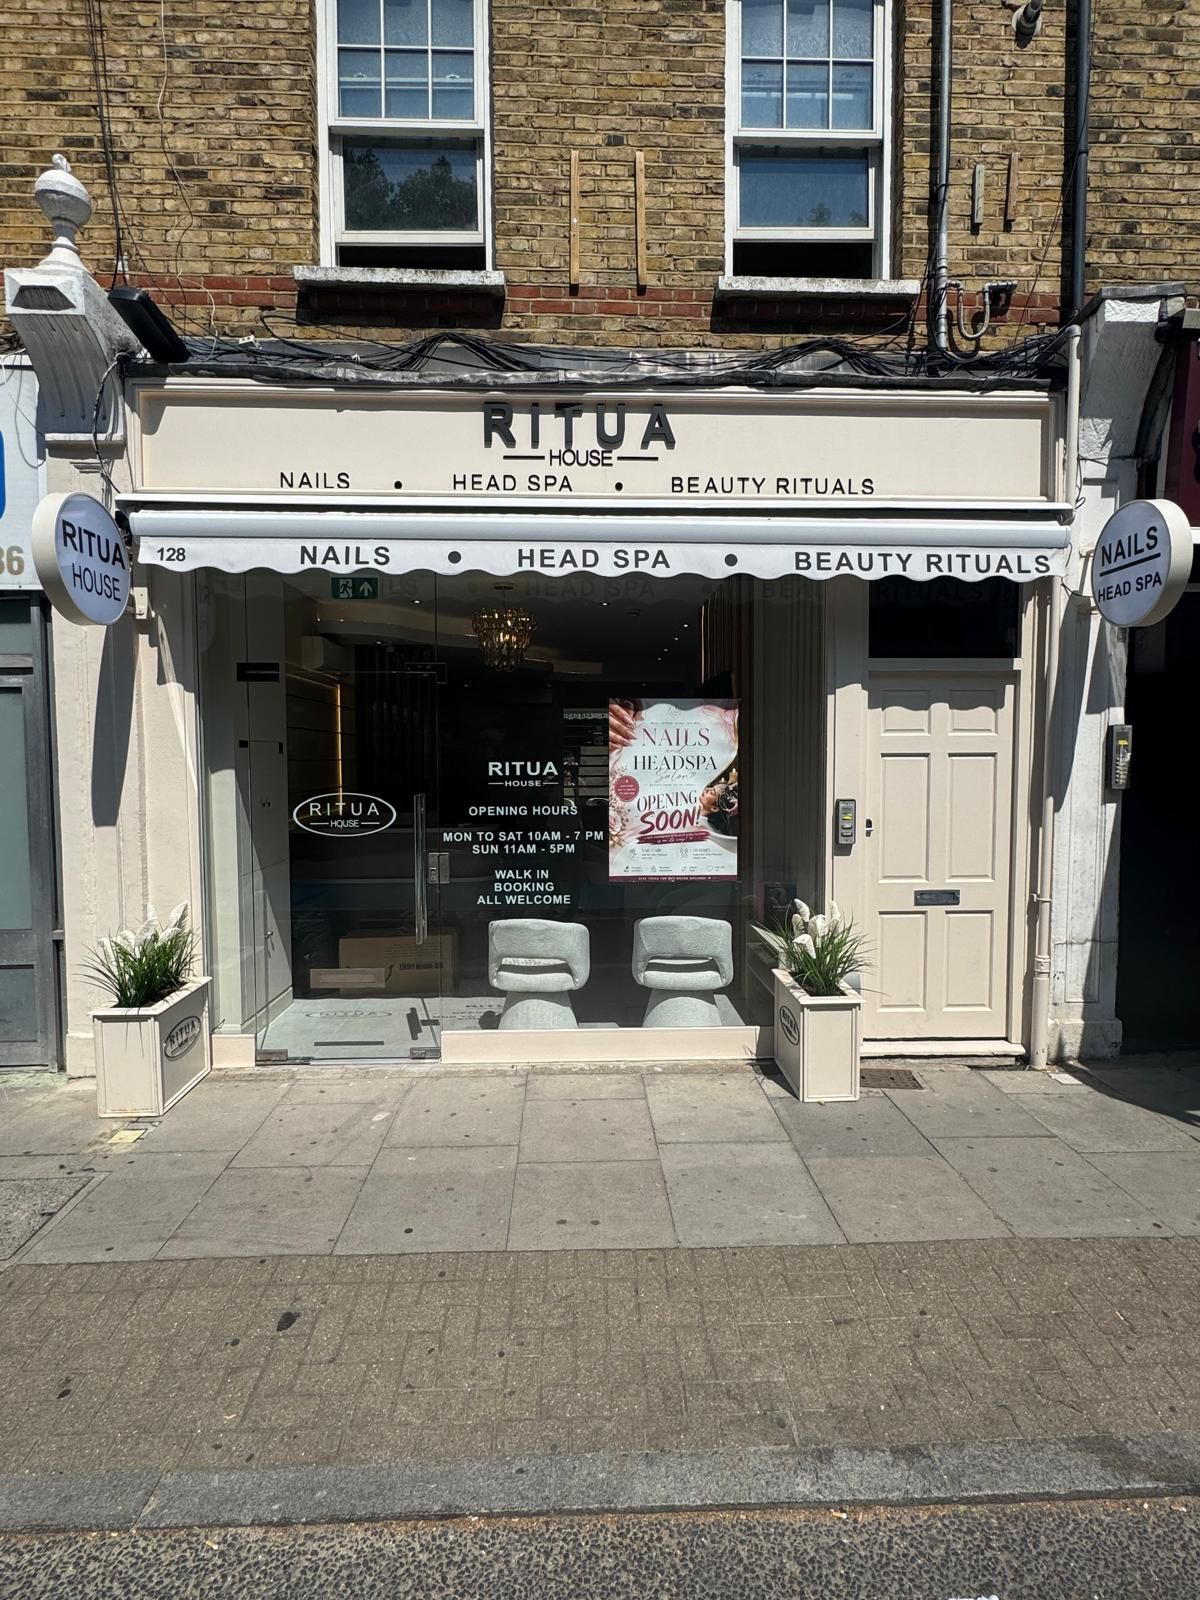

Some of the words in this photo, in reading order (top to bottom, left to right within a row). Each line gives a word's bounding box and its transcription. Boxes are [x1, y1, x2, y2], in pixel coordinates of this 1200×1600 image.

[483, 401, 675, 449] RITUA
[549, 449, 614, 466] HOUSE
[280, 472, 350, 489] NAILS
[453, 474, 517, 491] HEAD
[527, 475, 573, 492] SPA
[671, 476, 766, 494] BEAUTY
[776, 477, 875, 495] RITUALS
[62, 519, 125, 570] RITUA
[1101, 526, 1158, 567] NAILS
[0, 545, 24, 576] 6
[156, 547, 186, 562] 128
[300, 545, 390, 566] NAILS
[518, 548, 599, 569] HEAD
[613, 549, 671, 569] SPA
[794, 551, 912, 573] BEAUTY
[926, 553, 1051, 575] RITUALS
[72, 563, 121, 602] HOUSE
[1098, 580, 1131, 603] HEAD
[1135, 571, 1162, 592] SPA
[642, 728, 710, 746] NAILS
[488, 761, 559, 776] RITUA
[634, 755, 717, 770] HEADSPA
[309, 802, 380, 817] RITUA
[636, 790, 697, 812] OPENING
[468, 806, 528, 816] OPENING
[532, 805, 578, 816] HOURS
[639, 805, 701, 834] SOON!
[330, 819, 360, 828] HOUSE
[443, 832, 472, 842] MON
[477, 832, 494, 842] TO
[498, 831, 523, 841] SAT
[527, 831, 561, 841] 10AM
[574, 831, 581, 841] 7
[585, 831, 604, 841] PM
[472, 844, 499, 854] SUN
[503, 844, 537, 854] 11AM
[549, 844, 575, 853] 5PM
[494, 869, 532, 879] WALK
[536, 869, 549, 879] IN
[494, 882, 555, 892] BOOKING
[476, 895, 502, 905] ALL
[505, 894, 571, 905] WELCOME
